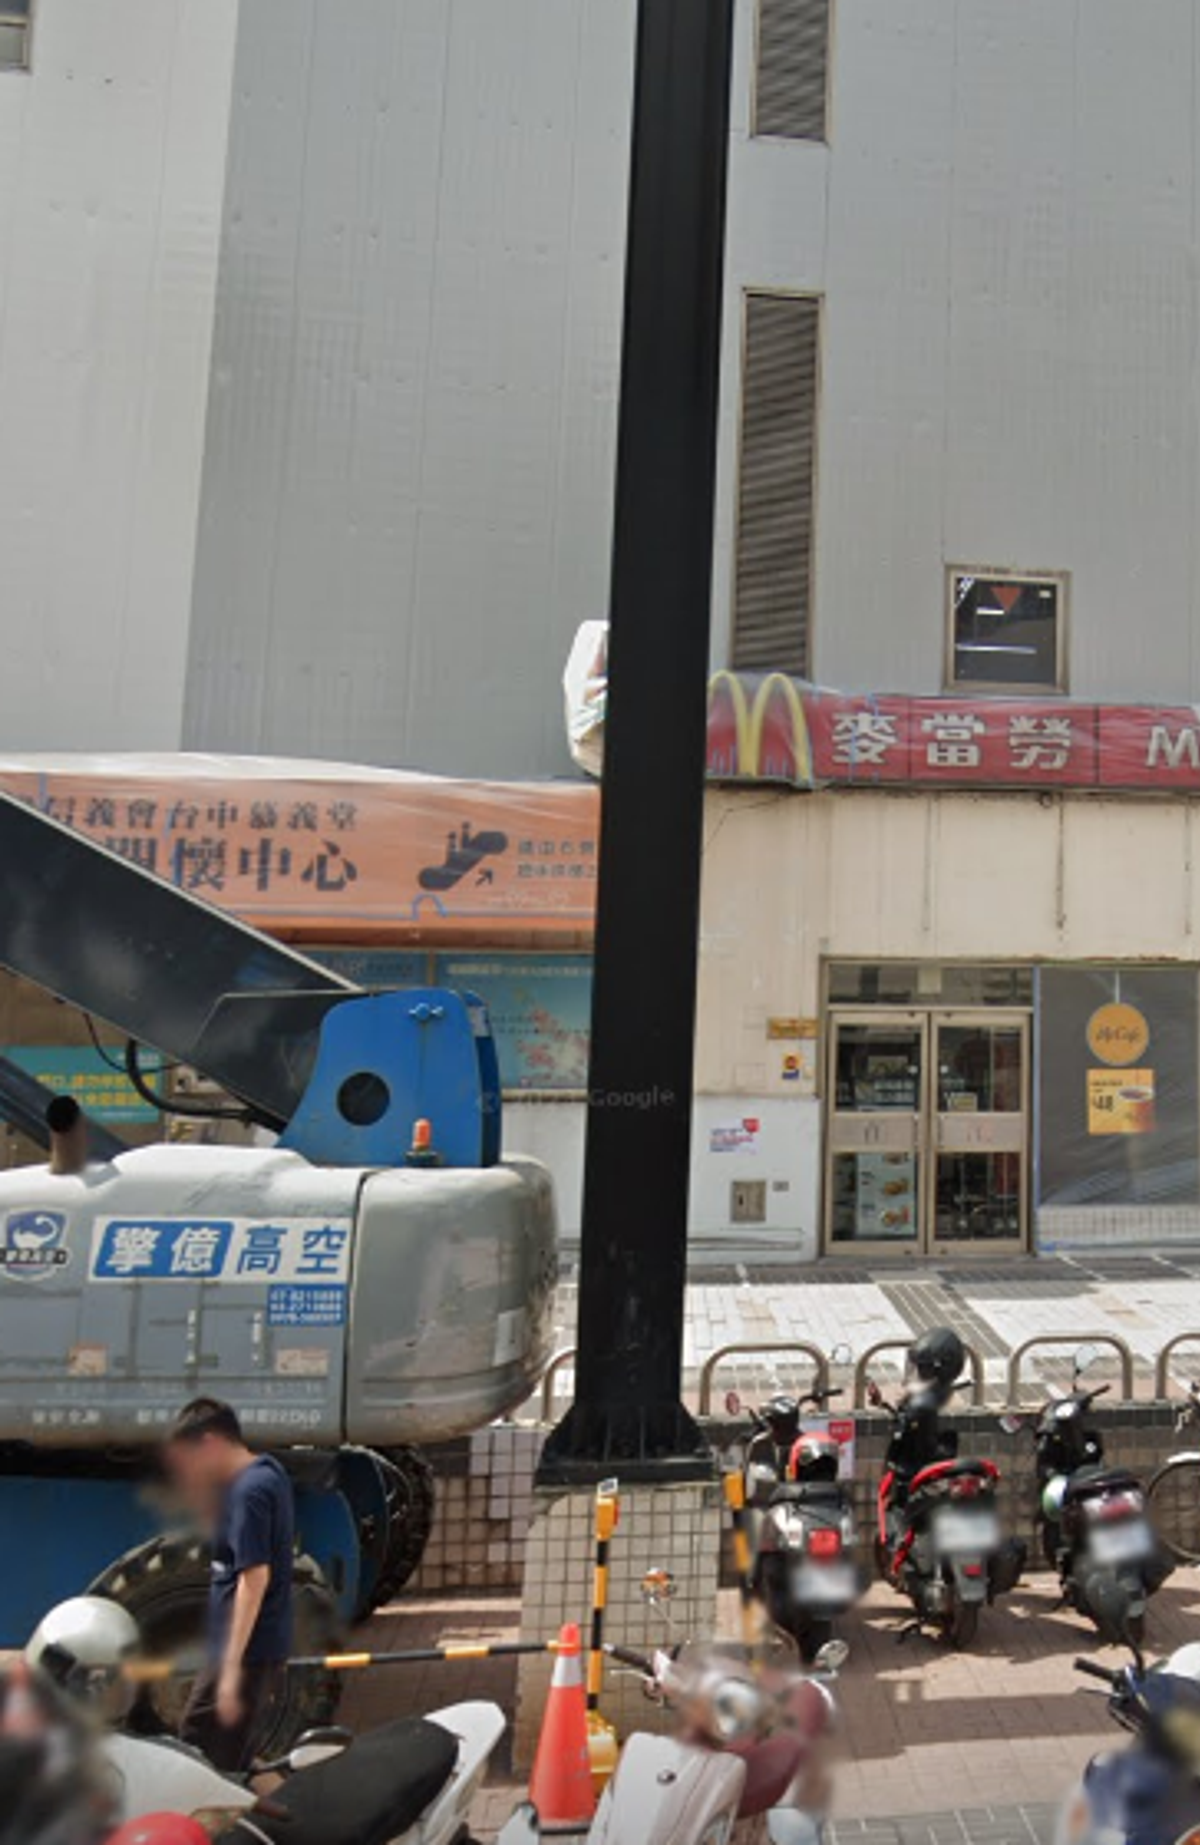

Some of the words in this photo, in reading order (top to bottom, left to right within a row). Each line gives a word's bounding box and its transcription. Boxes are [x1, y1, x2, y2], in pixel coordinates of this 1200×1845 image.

[832, 712, 1071, 769] 麥當勞
[106, 1226, 348, 1275] 擎億高空
